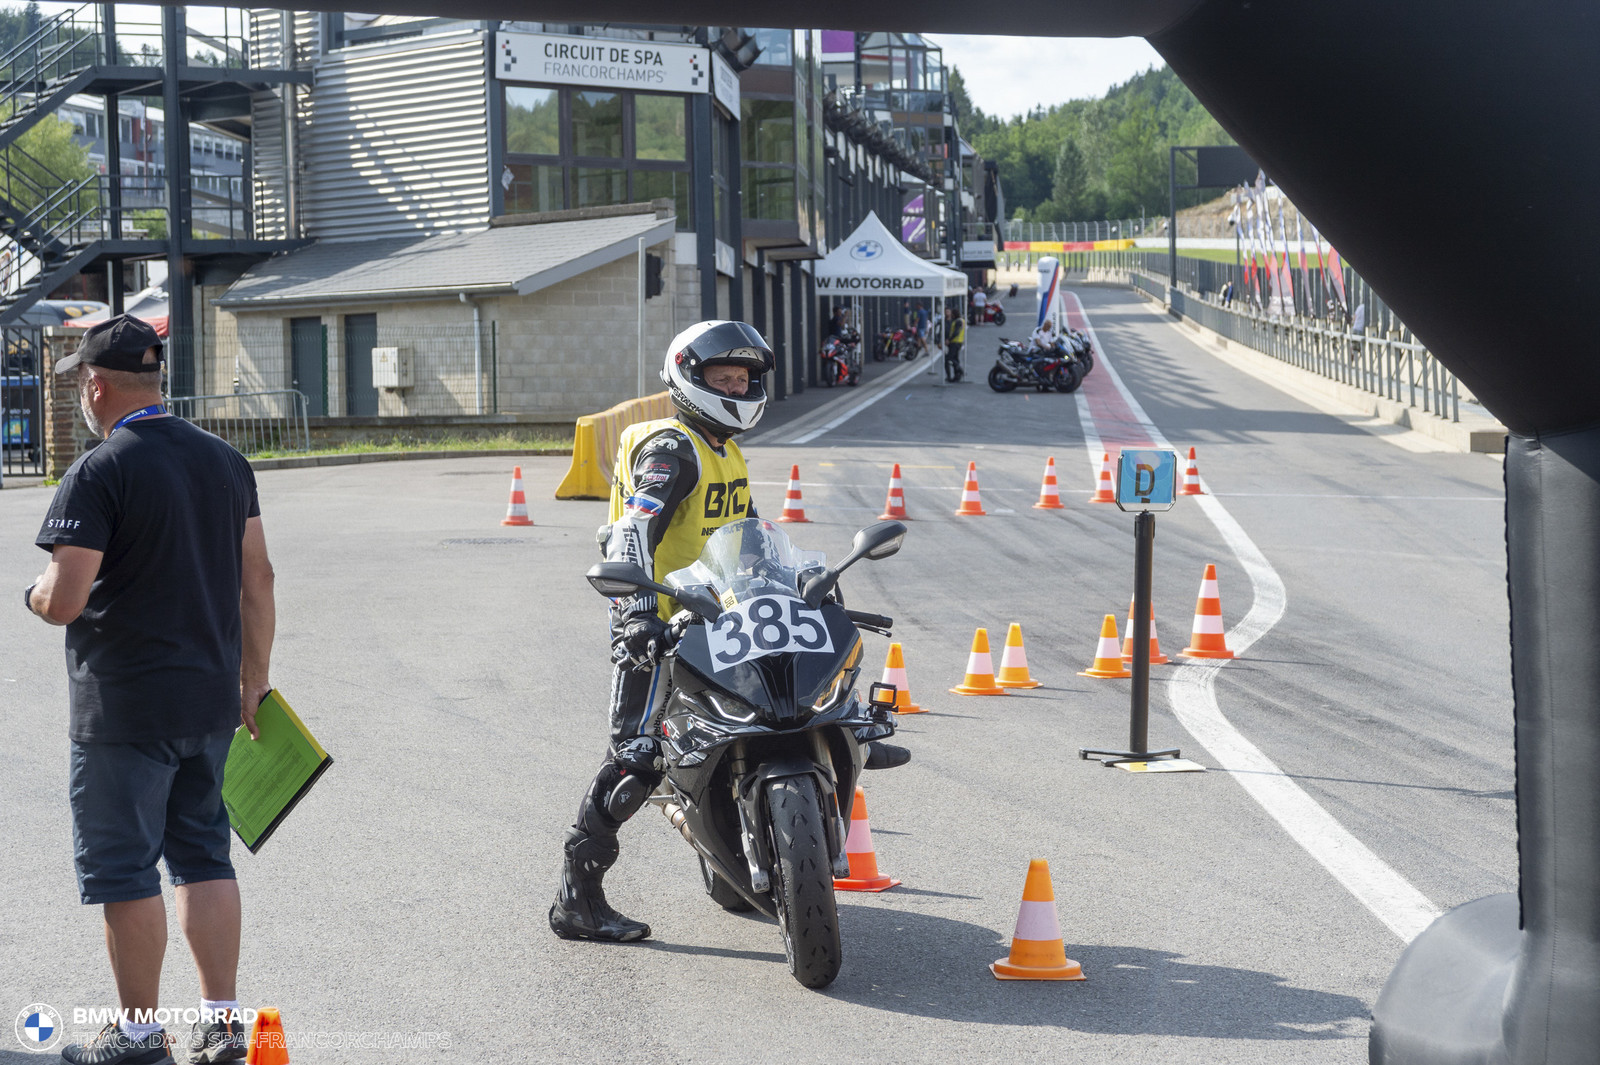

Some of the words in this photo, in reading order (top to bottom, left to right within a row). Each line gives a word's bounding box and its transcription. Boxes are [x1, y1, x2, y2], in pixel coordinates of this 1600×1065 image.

[544, 42, 605, 62] CIRCUIT
[609, 47, 630, 64] DE
[634, 50, 663, 66] SPA
[544, 61, 664, 83] FRANCORCHAMPS
[816, 277, 831, 289] W
[836, 277, 924, 289] MOTORRAD
[672, 388, 705, 415] SHARK
[1135, 464, 1155, 496] D
[47, 518, 81, 529] STAFF
[712, 598, 828, 664] 385
